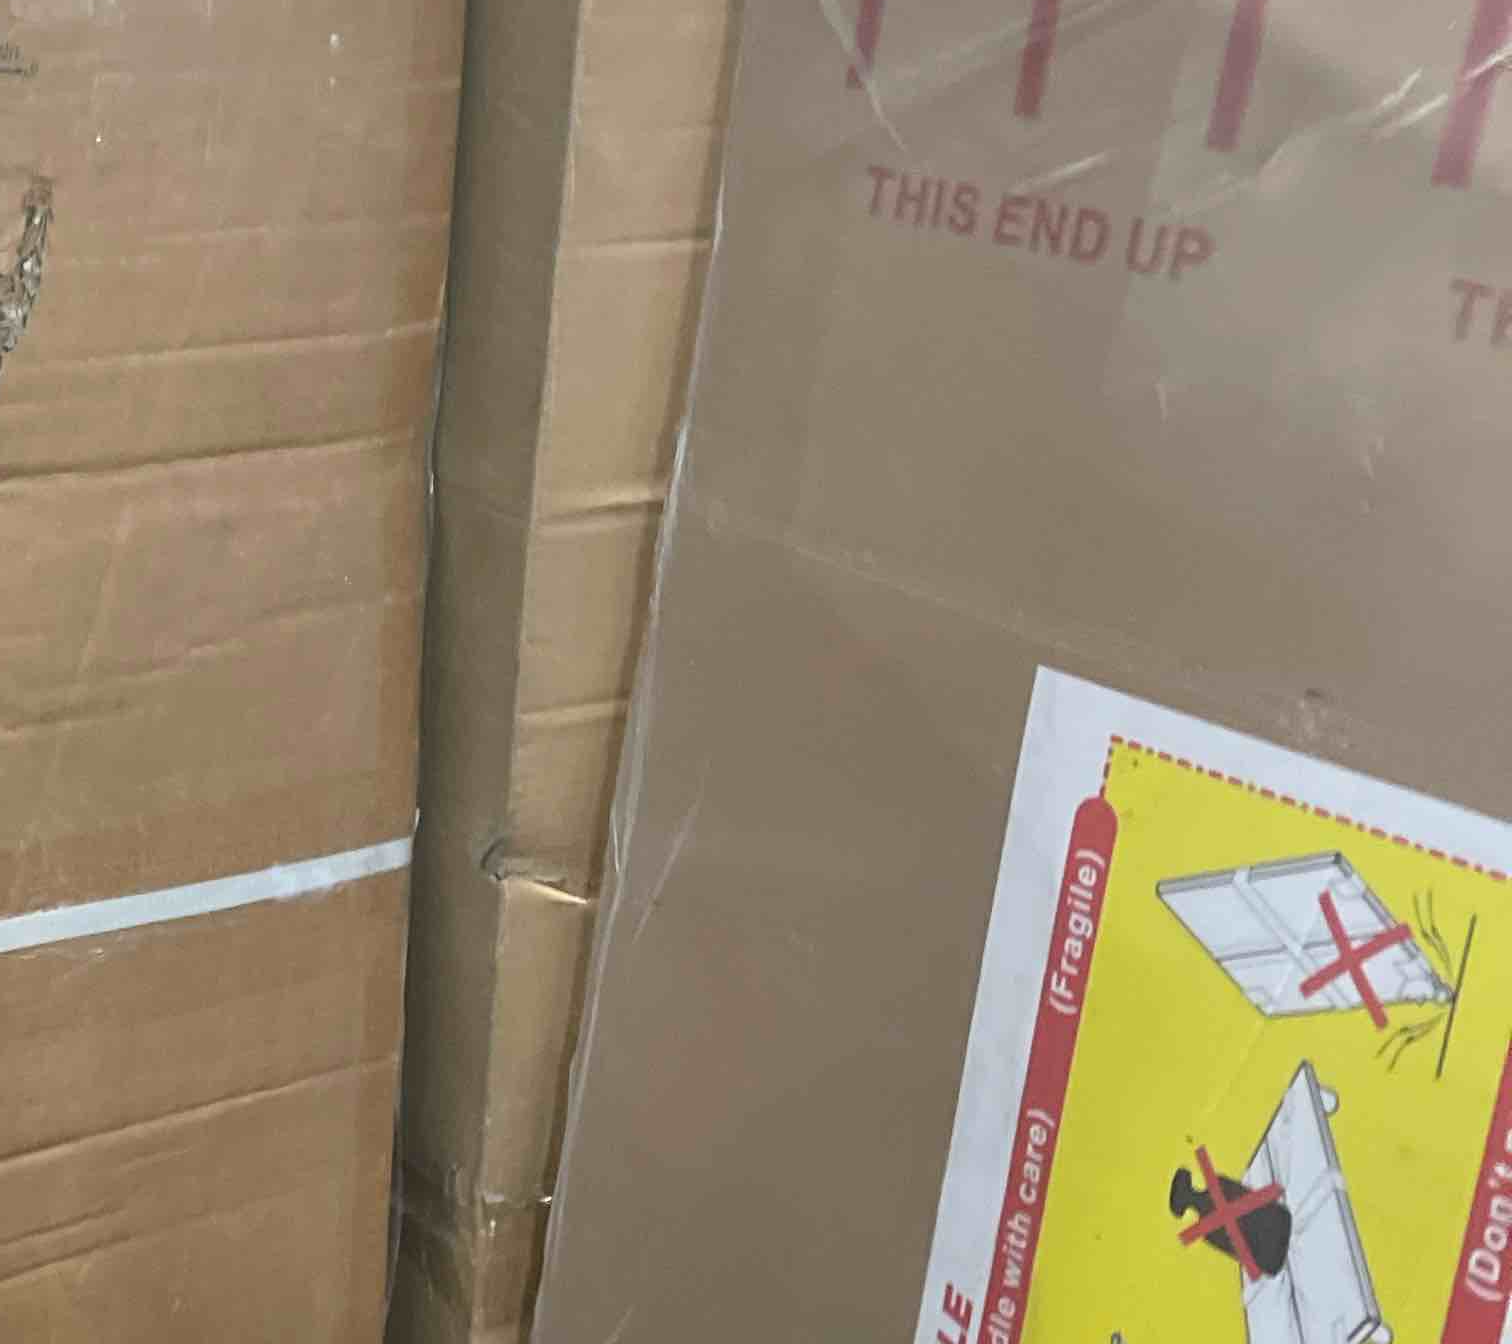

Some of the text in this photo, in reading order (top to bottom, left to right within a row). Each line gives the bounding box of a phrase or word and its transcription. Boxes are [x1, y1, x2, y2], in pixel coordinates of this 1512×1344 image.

[866, 164, 1215, 283] THIS END UP
[1049, 848, 1107, 1015] (Fragile)
[1002, 1211, 1033, 1289] with
[1018, 1109, 1055, 1204] care)
